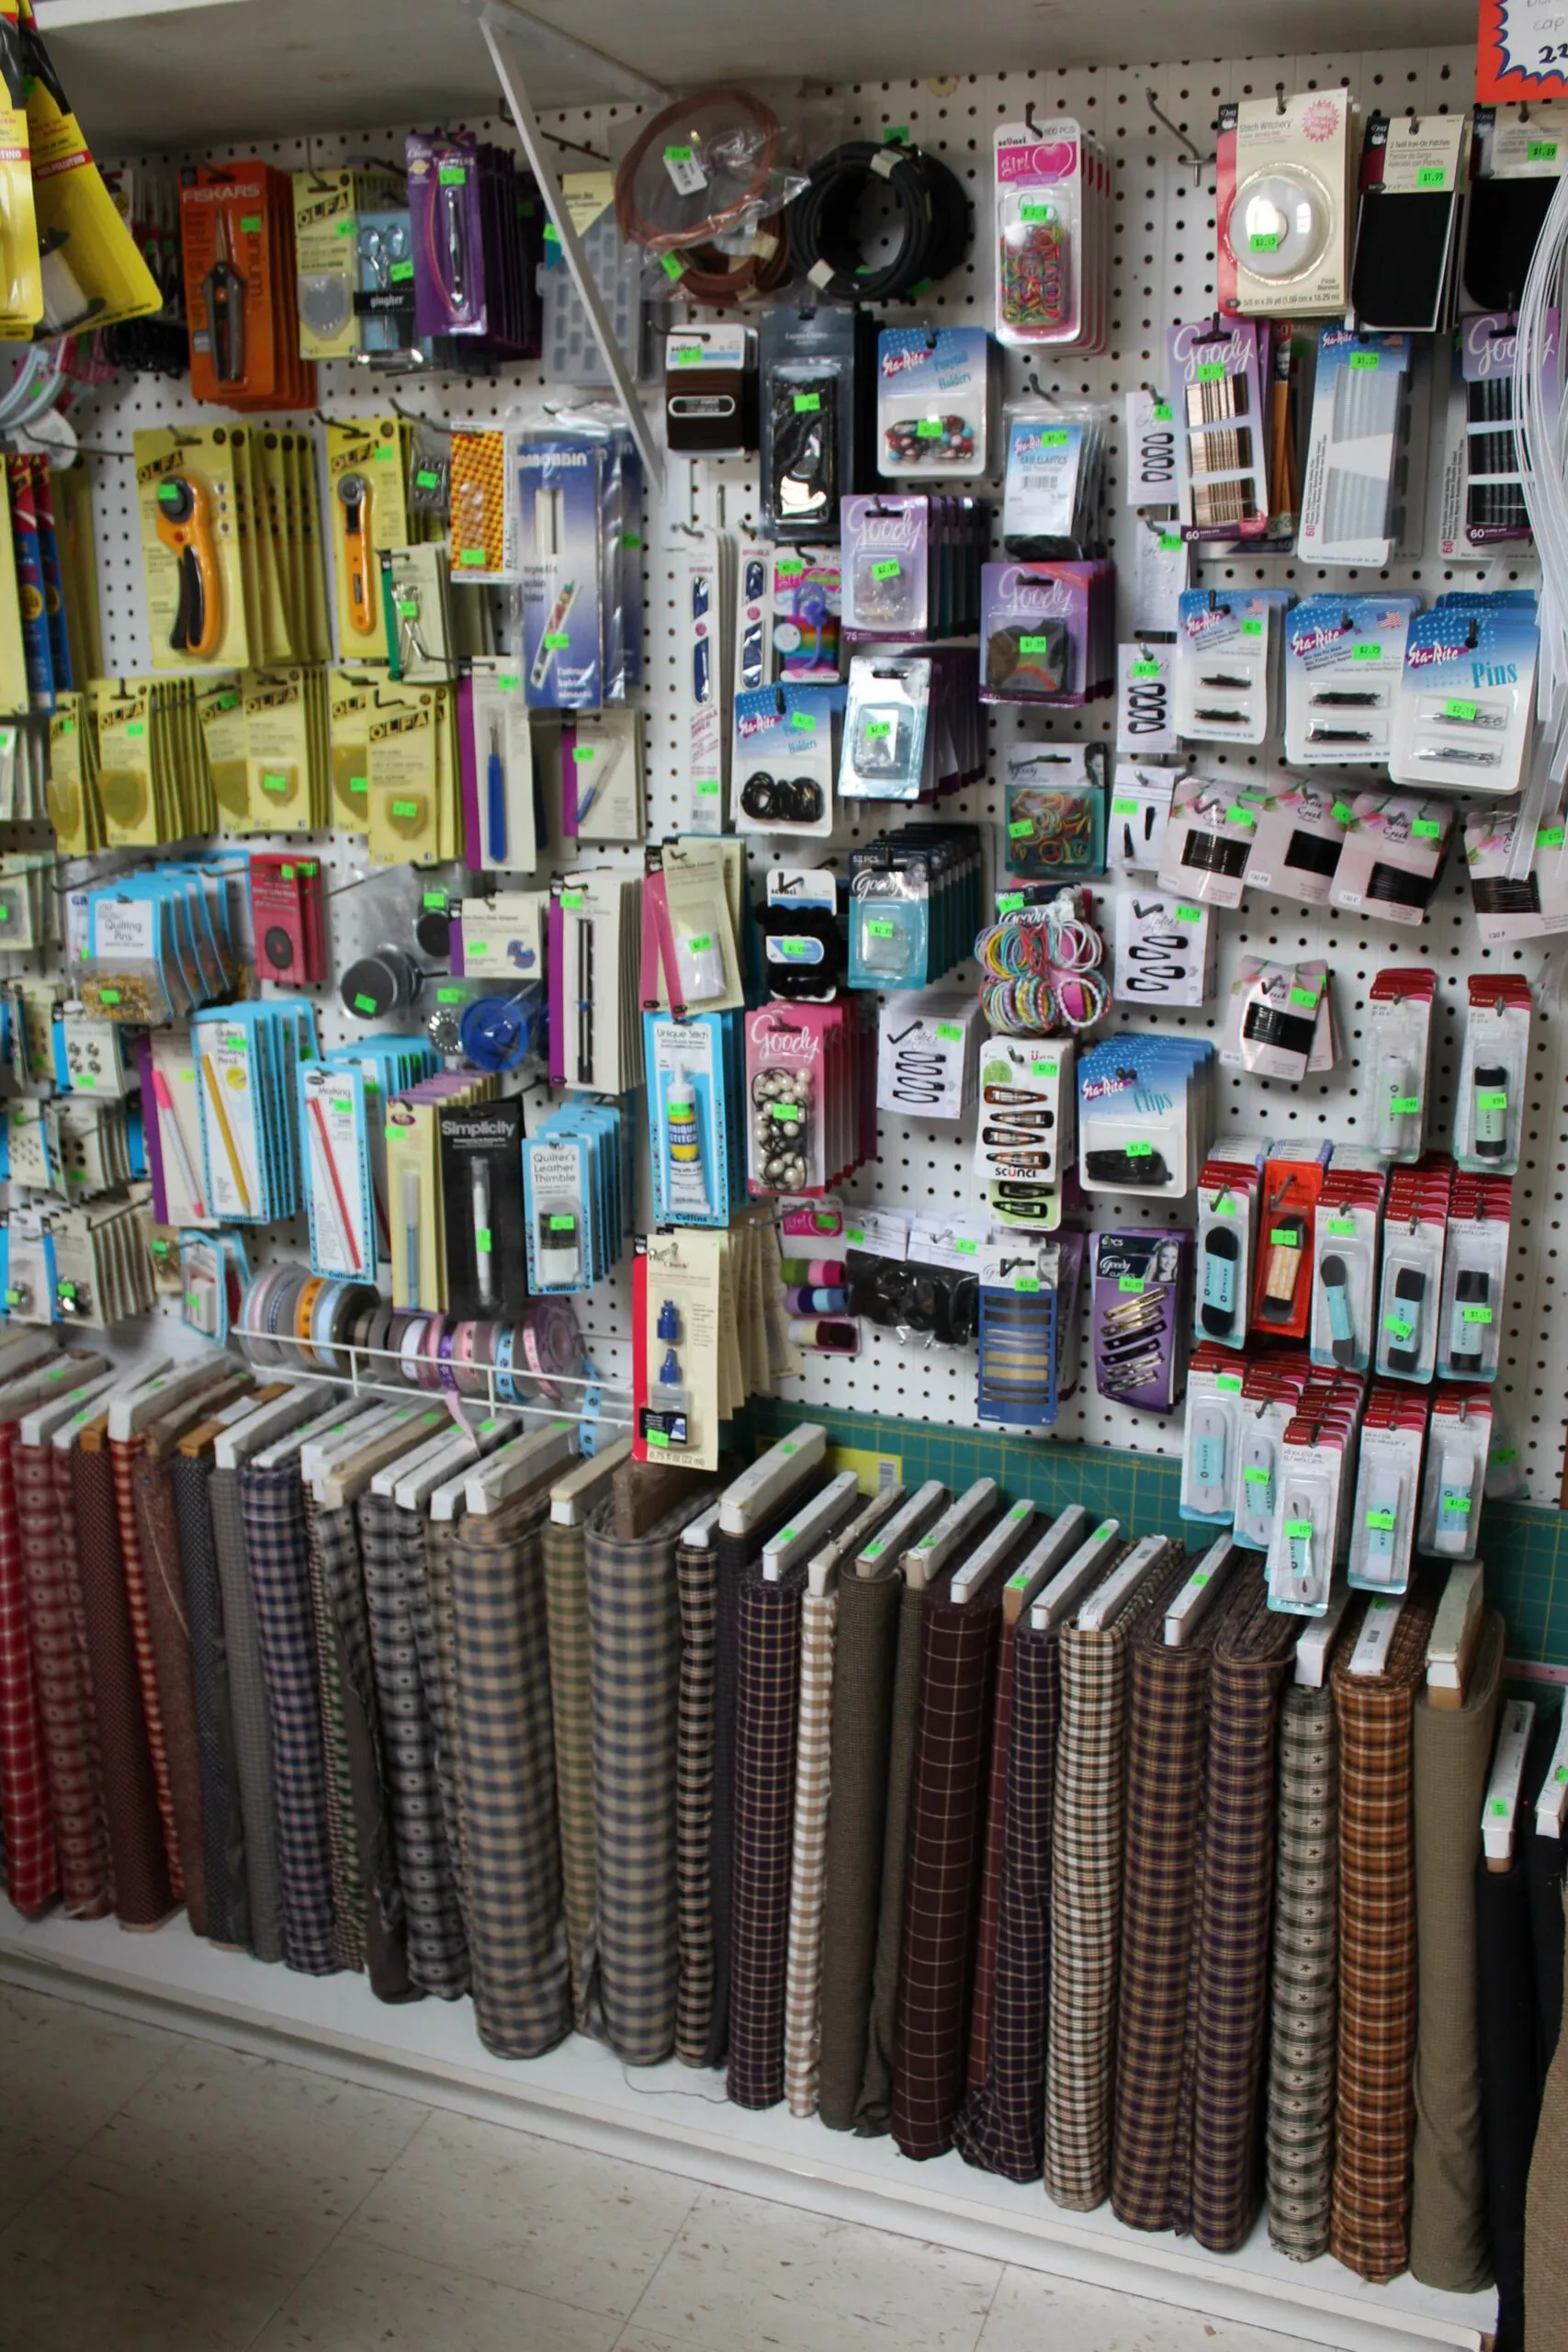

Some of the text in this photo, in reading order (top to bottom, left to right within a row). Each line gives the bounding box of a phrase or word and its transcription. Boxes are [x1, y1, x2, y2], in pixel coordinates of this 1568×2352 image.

[182, 185, 260, 204] FISKARS
[297, 191, 351, 228] OLFA
[1321, 330, 1355, 347] Sta-Rite
[881, 349, 925, 376] Sta-Rite
[1173, 324, 1255, 380] Goody
[137, 449, 185, 483] OLFA
[848, 499, 924, 555] Goody
[1186, 529, 1200, 541] 60
[998, 566, 1074, 616] Goody
[1186, 609, 1221, 637] Sta-Rite
[1291, 626, 1340, 655] Sta-Rite
[1407, 641, 1459, 670] Sta-Rite
[1472, 661, 1518, 689] Pins
[99, 699, 146, 729] OLFA
[244, 686, 300, 717] OLFA
[332, 695, 367, 719] OLF
[368, 709, 430, 742] OLFA
[739, 714, 777, 737] Sta-Rite
[104, 920, 142, 934] Quilting
[657, 1027, 709, 1040] Unique Stitch
[750, 1013, 820, 1063] Goody
[1082, 1079, 1125, 1101] Sta-Rite
[1134, 1089, 1174, 1115] Clips
[442, 1120, 515, 1138] Simplicity
[533, 1151, 577, 1164] Quilter's
[533, 1163, 575, 1173] Leather
[533, 1172, 577, 1184] Thimble
[675, 1213, 708, 1224] Collins
[1100, 1255, 1132, 1274] Goody
